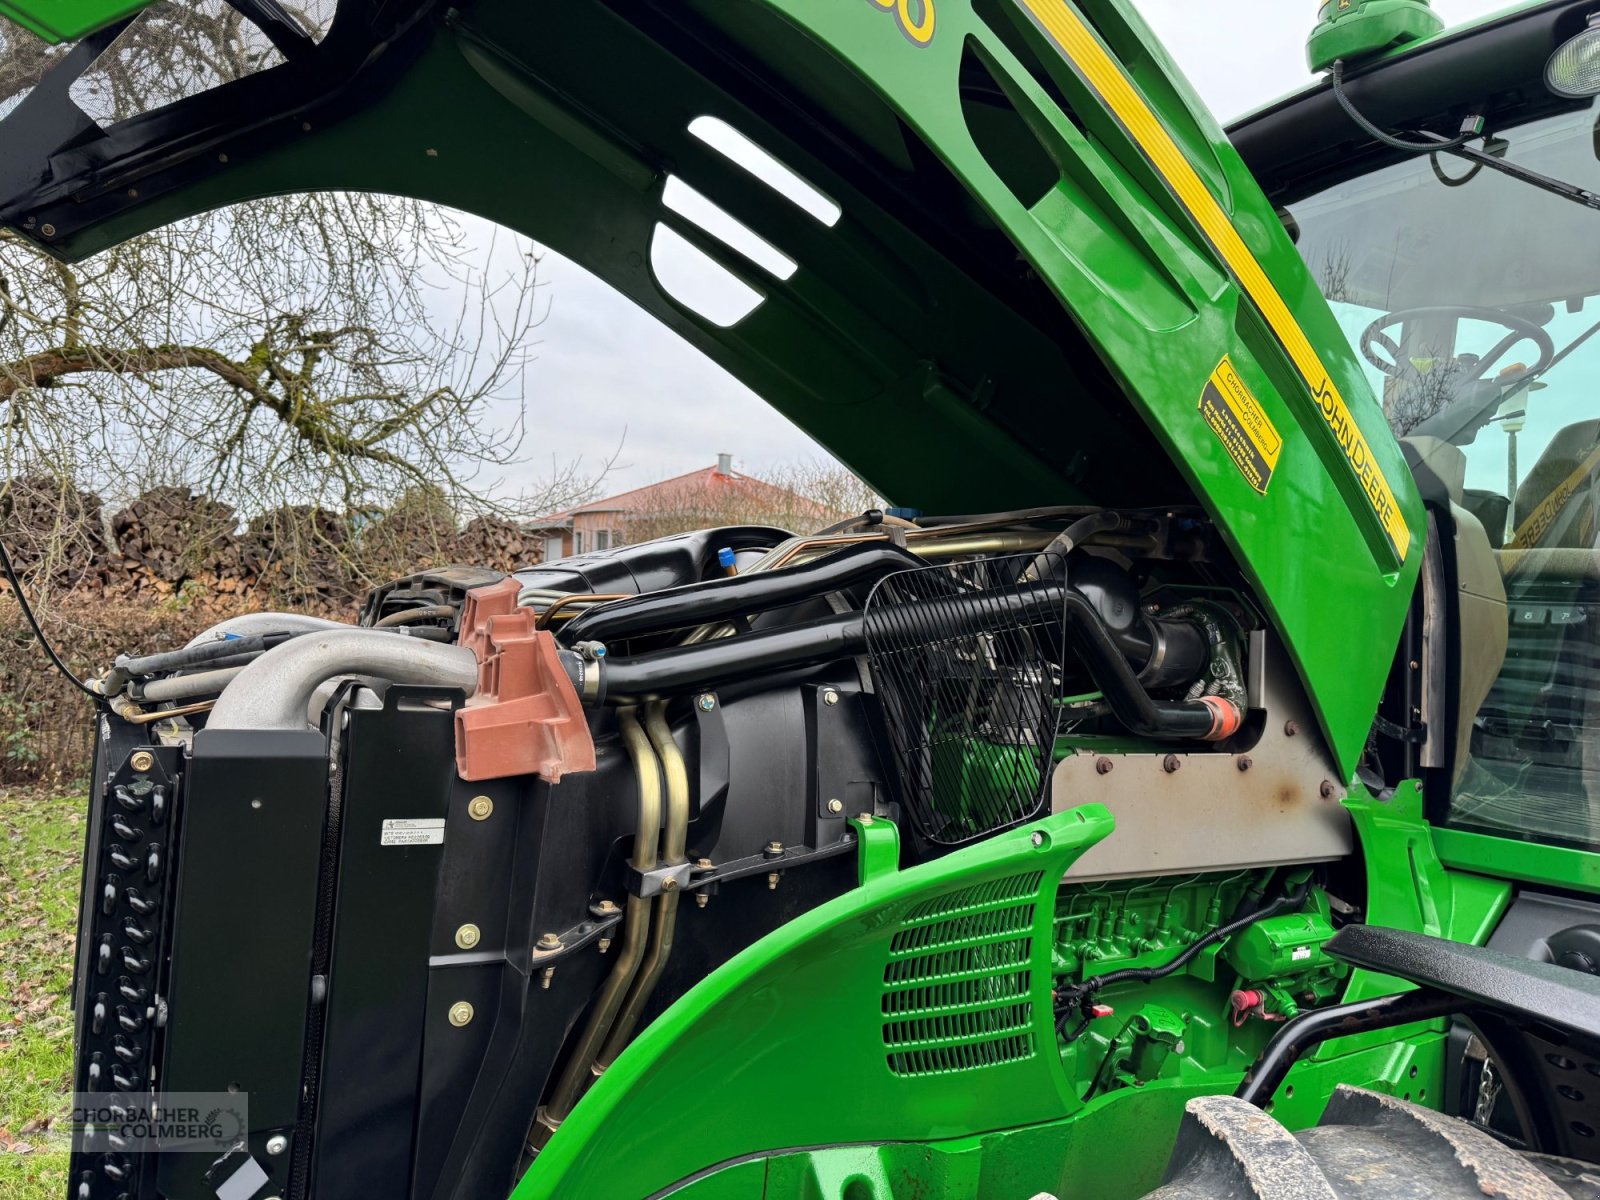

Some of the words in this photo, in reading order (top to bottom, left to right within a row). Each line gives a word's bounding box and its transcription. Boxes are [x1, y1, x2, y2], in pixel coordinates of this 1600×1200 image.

[1226, 372, 1263, 428] CHORBACHER
[1242, 411, 1268, 451] COLMBERG
[1311, 378, 1354, 453] JOHN
[1351, 438, 1394, 528] DEERE
